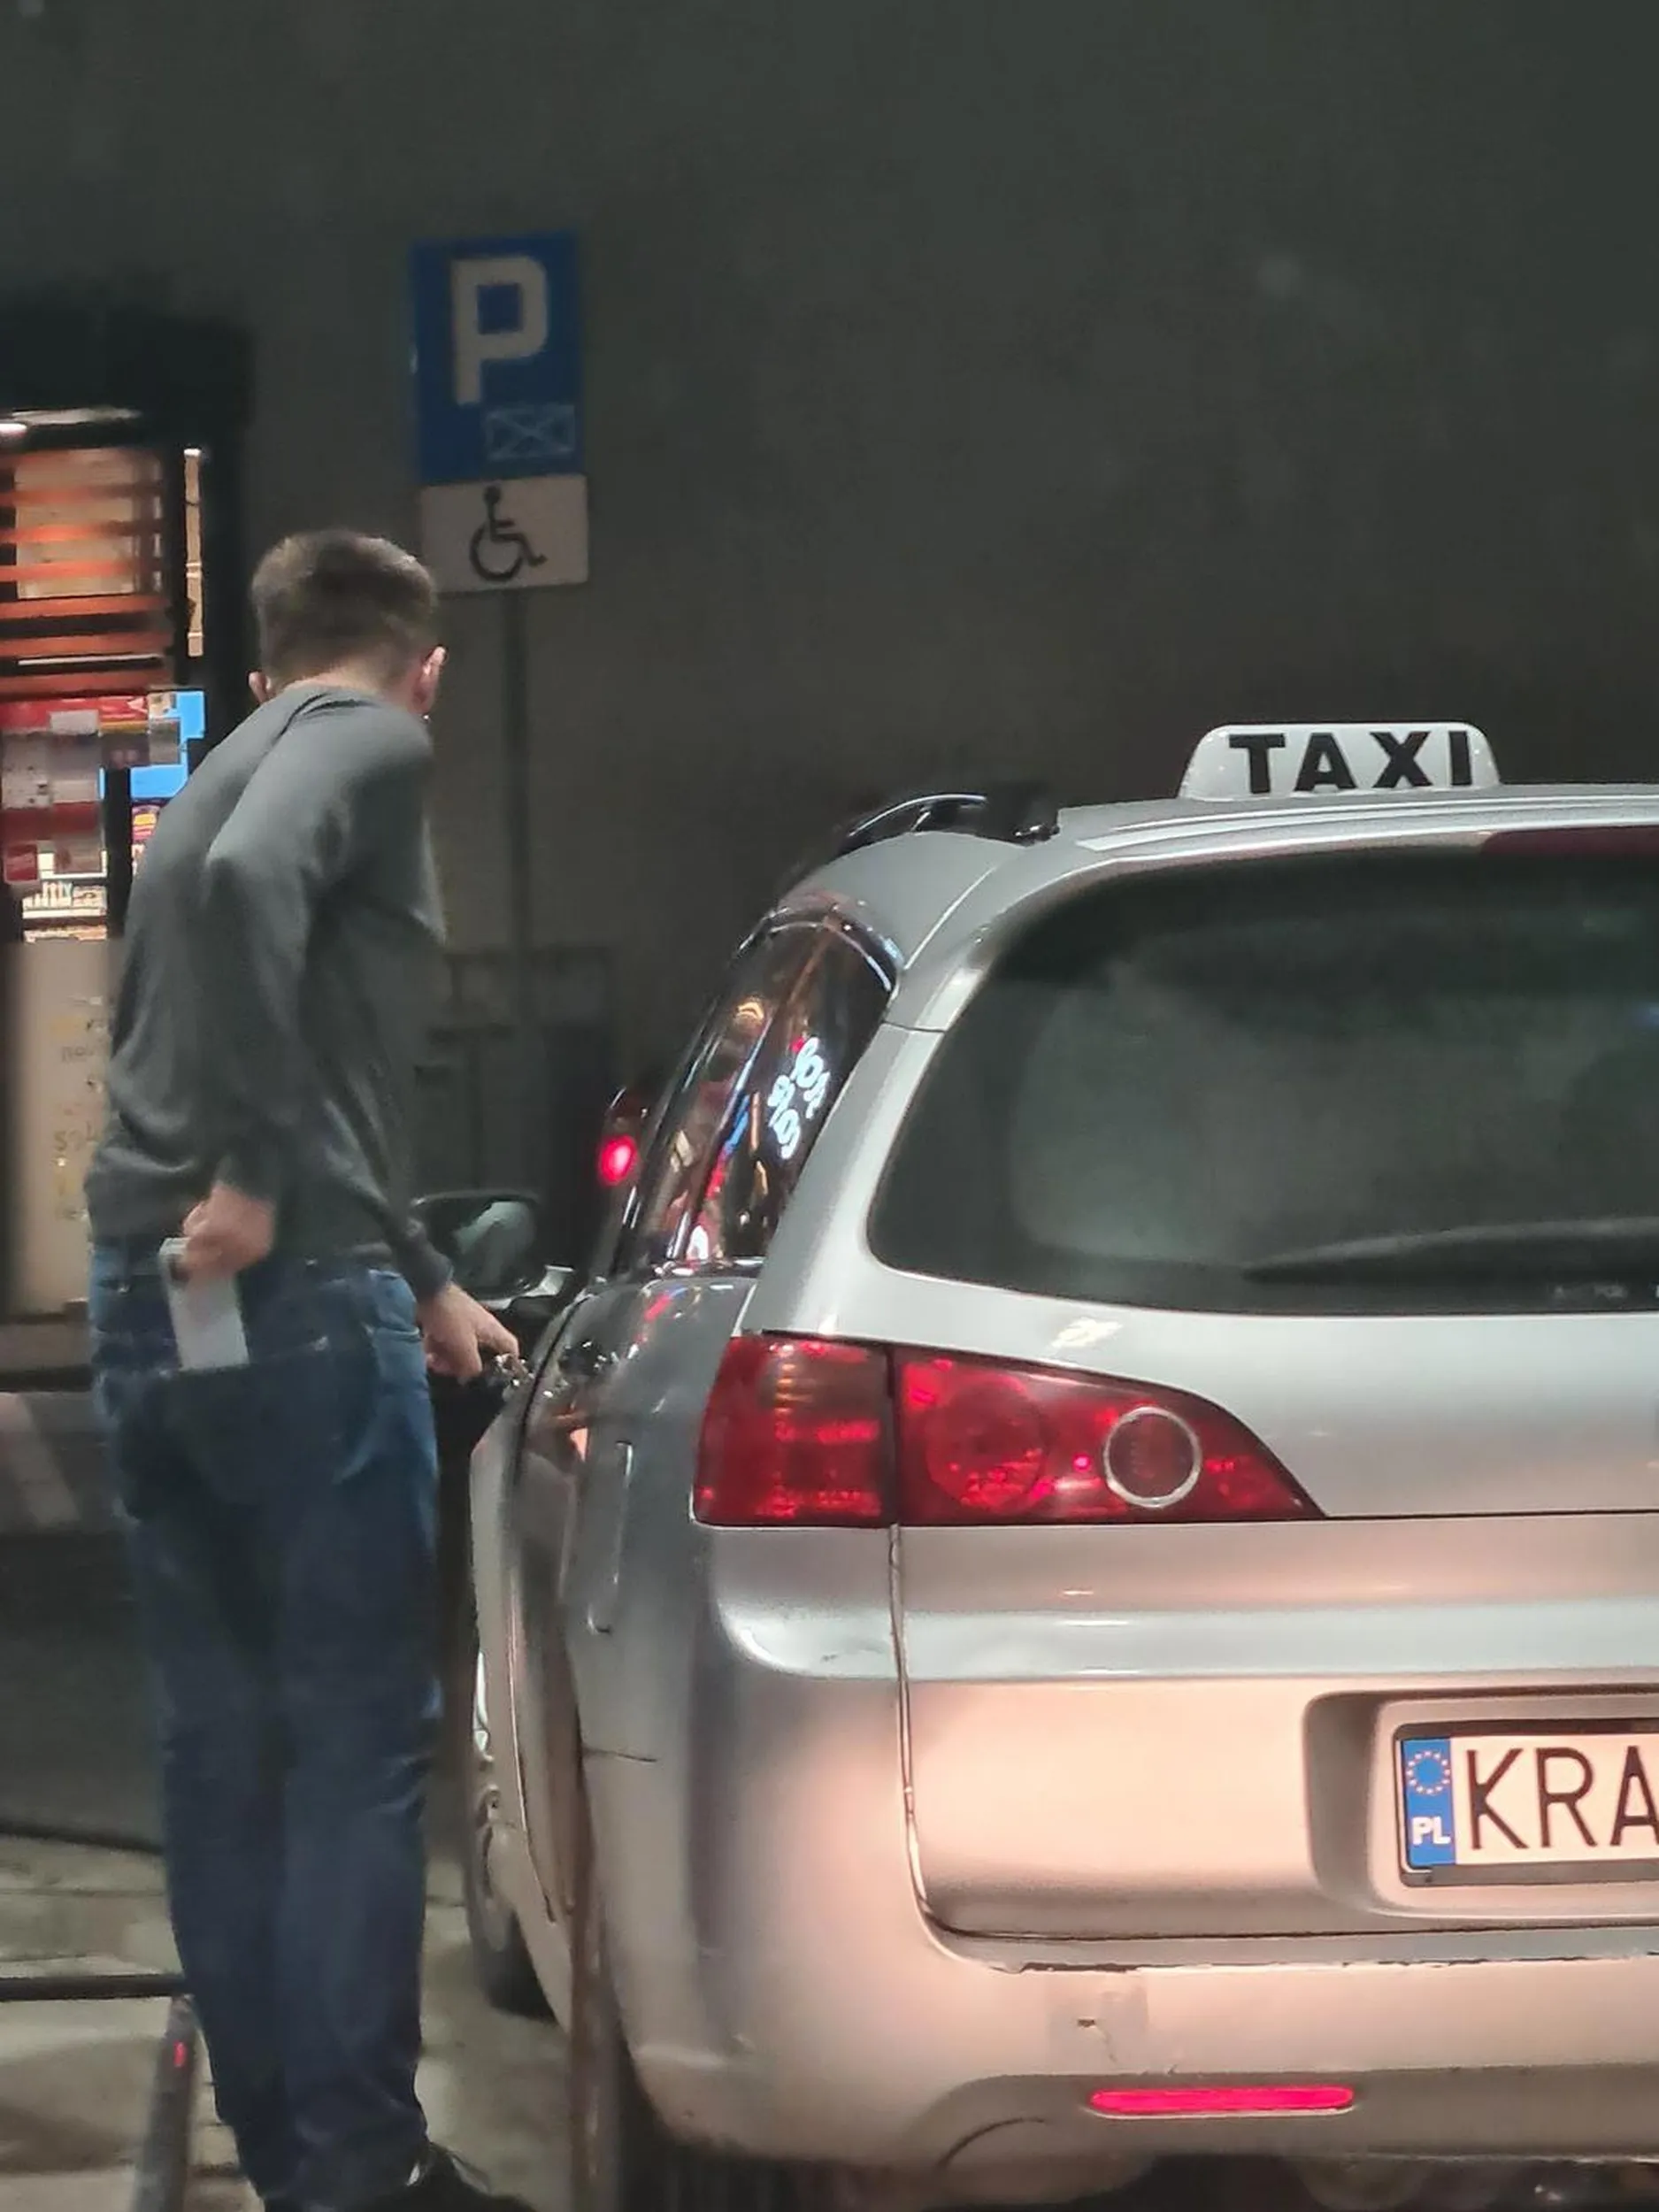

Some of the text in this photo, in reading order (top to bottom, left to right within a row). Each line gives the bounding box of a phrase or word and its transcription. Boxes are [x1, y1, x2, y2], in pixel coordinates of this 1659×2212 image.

[451, 255, 548, 406] P
[1228, 731, 1477, 794] TAXI
[1411, 1816, 1451, 1846] PL
[1466, 1745, 1659, 1850] KRA
